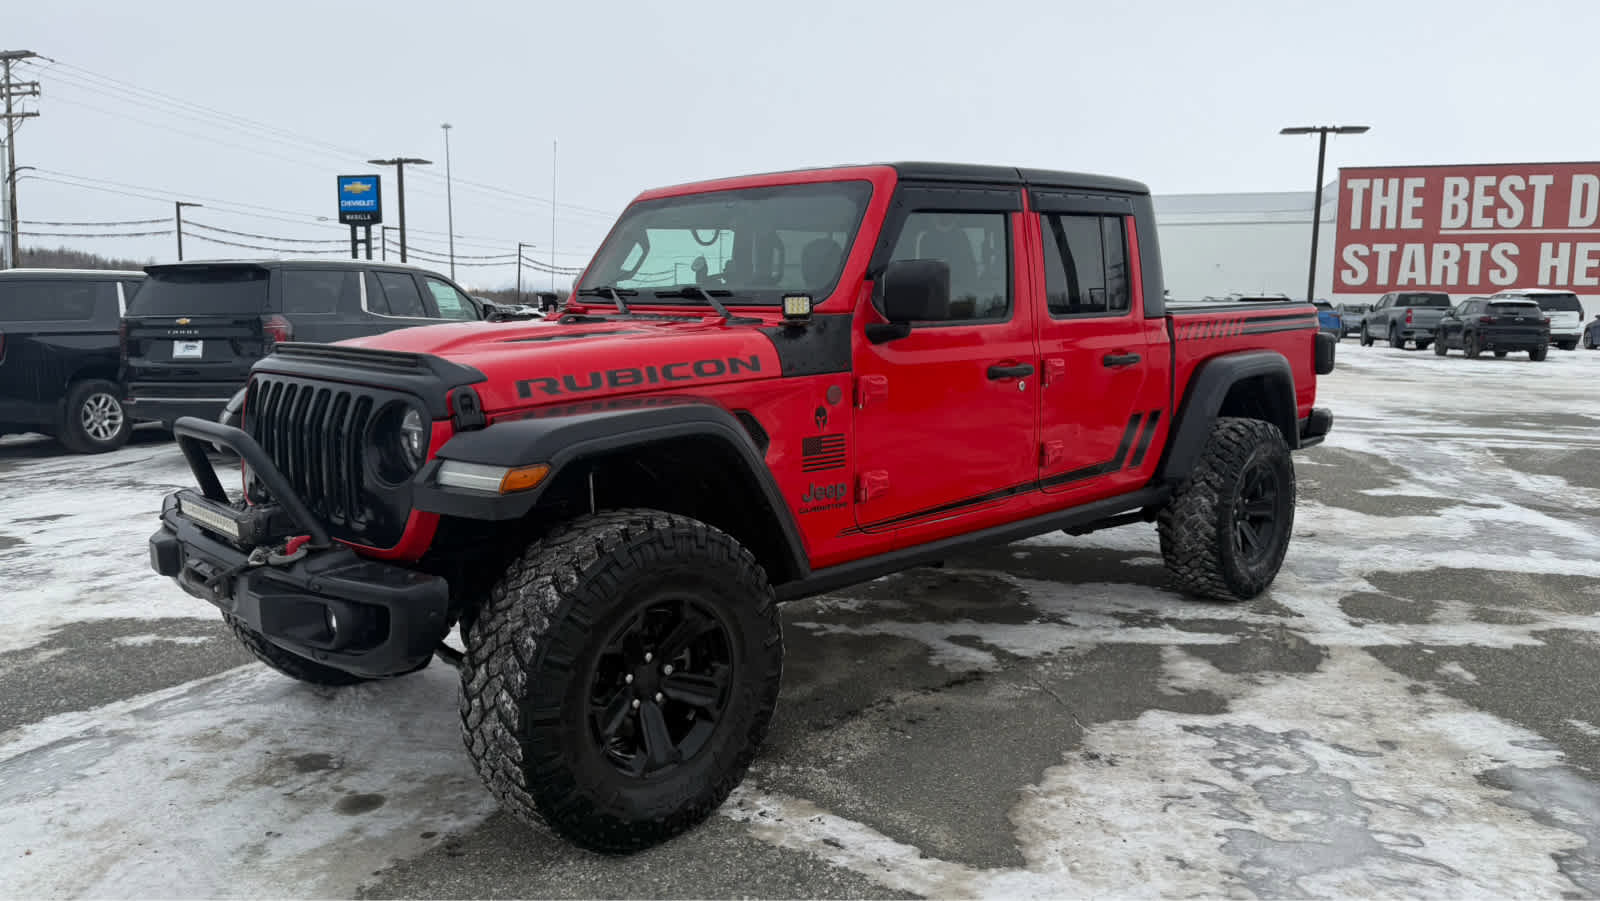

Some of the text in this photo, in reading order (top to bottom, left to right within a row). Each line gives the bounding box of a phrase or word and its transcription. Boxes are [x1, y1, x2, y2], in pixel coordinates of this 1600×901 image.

[1347, 177, 1426, 230] THE
[1441, 175, 1554, 229] BEST
[1340, 242, 1520, 286] STARTS
[515, 355, 761, 398] RUBICON
[802, 482, 847, 503] Jeep
